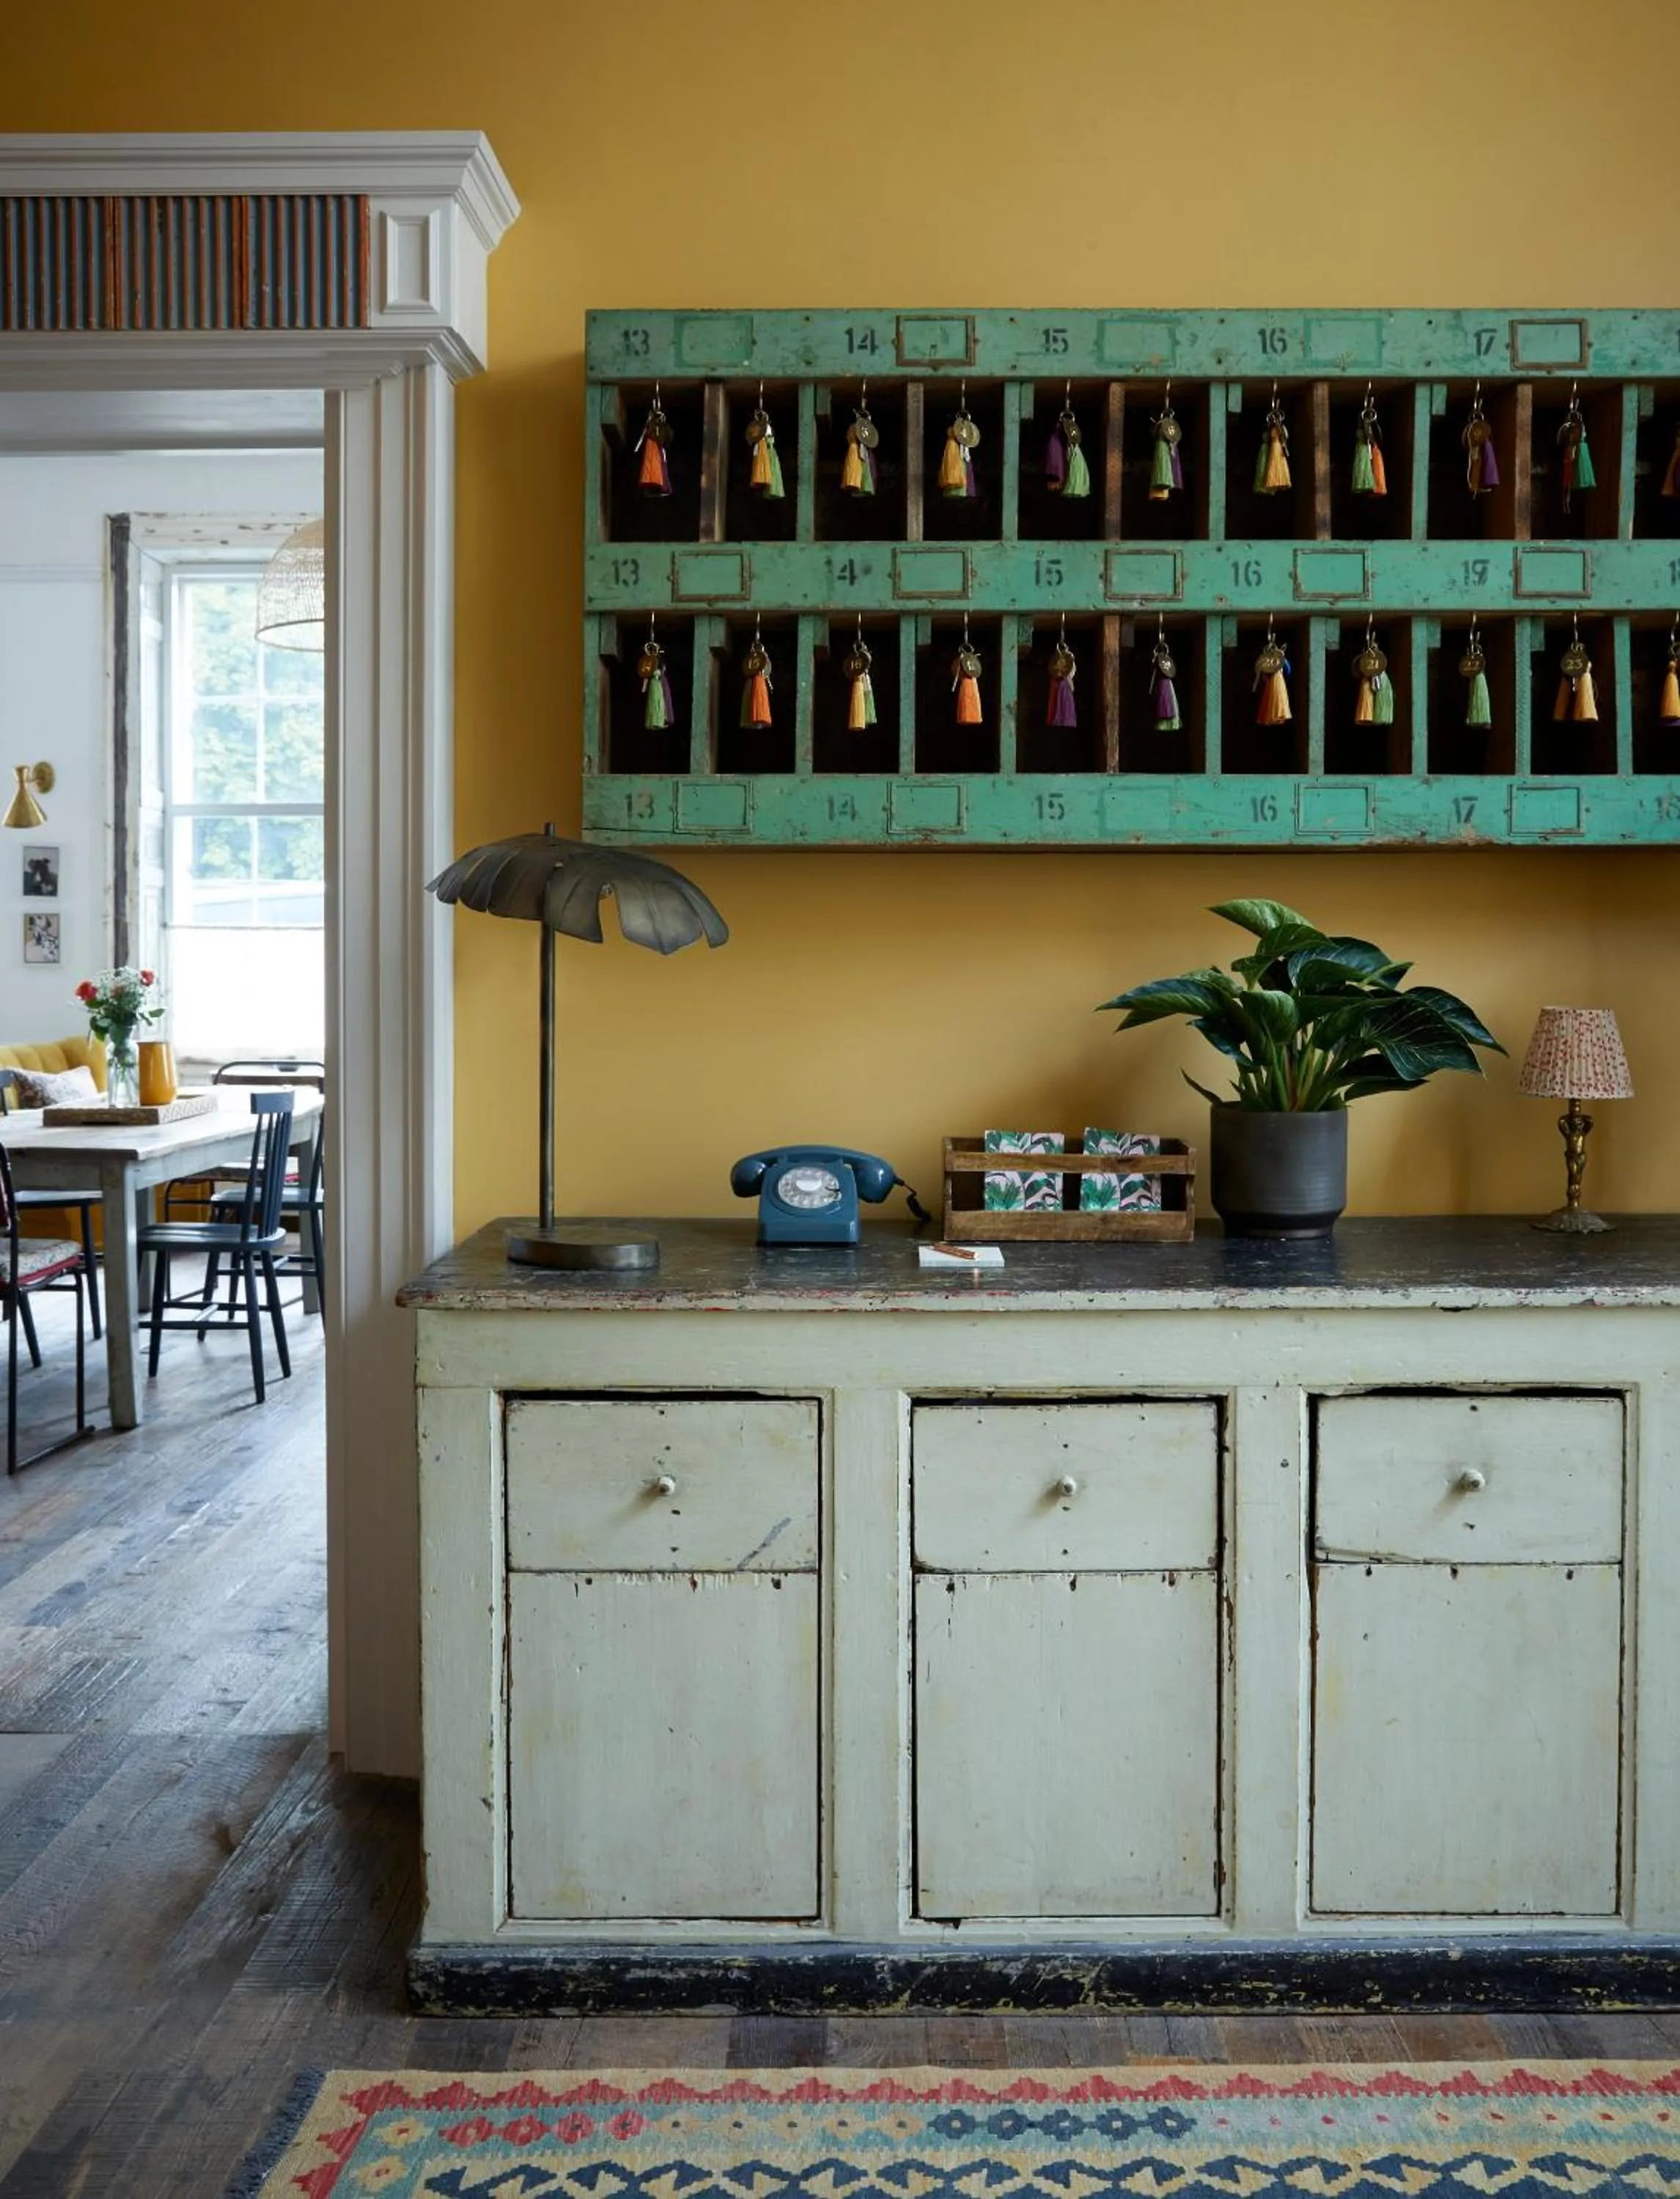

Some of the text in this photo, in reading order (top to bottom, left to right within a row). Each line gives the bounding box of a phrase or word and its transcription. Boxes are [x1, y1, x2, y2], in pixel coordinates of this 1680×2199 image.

[622, 329, 650, 356] 13
[844, 327, 878, 356] 14
[1042, 328, 1068, 354] 15
[1258, 328, 1287, 355] 16
[1473, 328, 1497, 356] 17
[612, 558, 640, 587] 13
[1034, 559, 1063, 587] 15
[1231, 560, 1261, 587] 16
[1668, 559, 1680, 586] 1
[1366, 658, 1379, 670] 21
[1566, 658, 1583, 670] 23
[625, 793, 655, 819] 13
[827, 795, 858, 822] 14
[1035, 792, 1064, 821] 15
[1250, 795, 1278, 823] 16
[1454, 795, 1478, 824] 17
